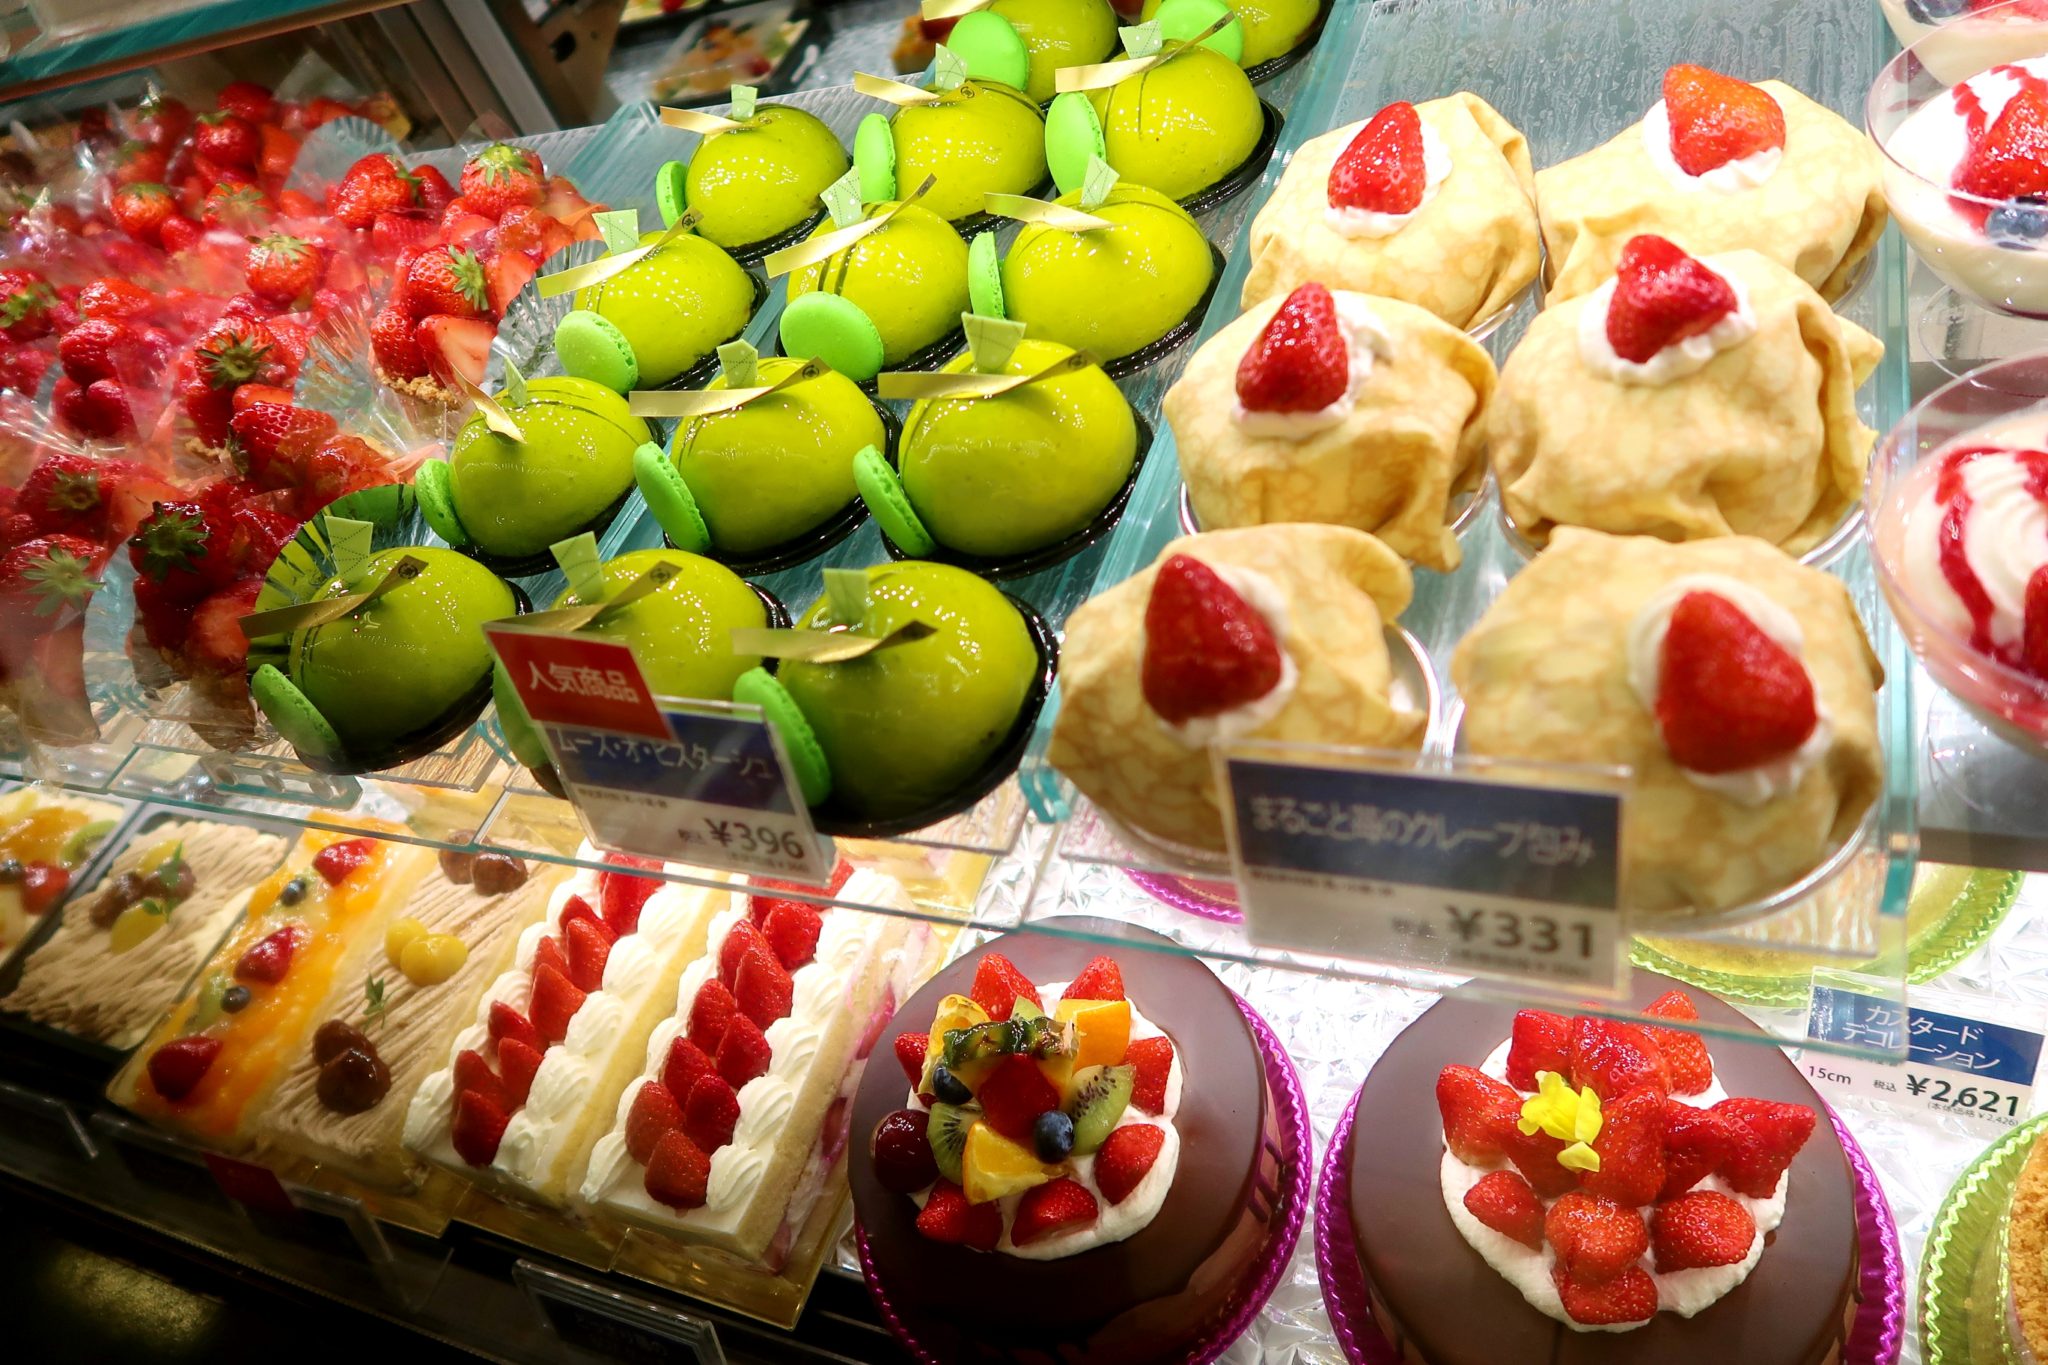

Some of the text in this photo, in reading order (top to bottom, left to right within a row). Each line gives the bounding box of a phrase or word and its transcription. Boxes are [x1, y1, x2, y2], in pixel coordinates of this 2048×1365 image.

[527, 661, 640, 703] 人気商品
[703, 817, 805, 859] ¥396
[1446, 905, 1595, 958] ¥331
[1843, 1022, 2000, 1070] デコレーション
[1867, 1005, 1984, 1046] カスタード
[1808, 1065, 2020, 1117] 15cm 税込 ¥2,621
